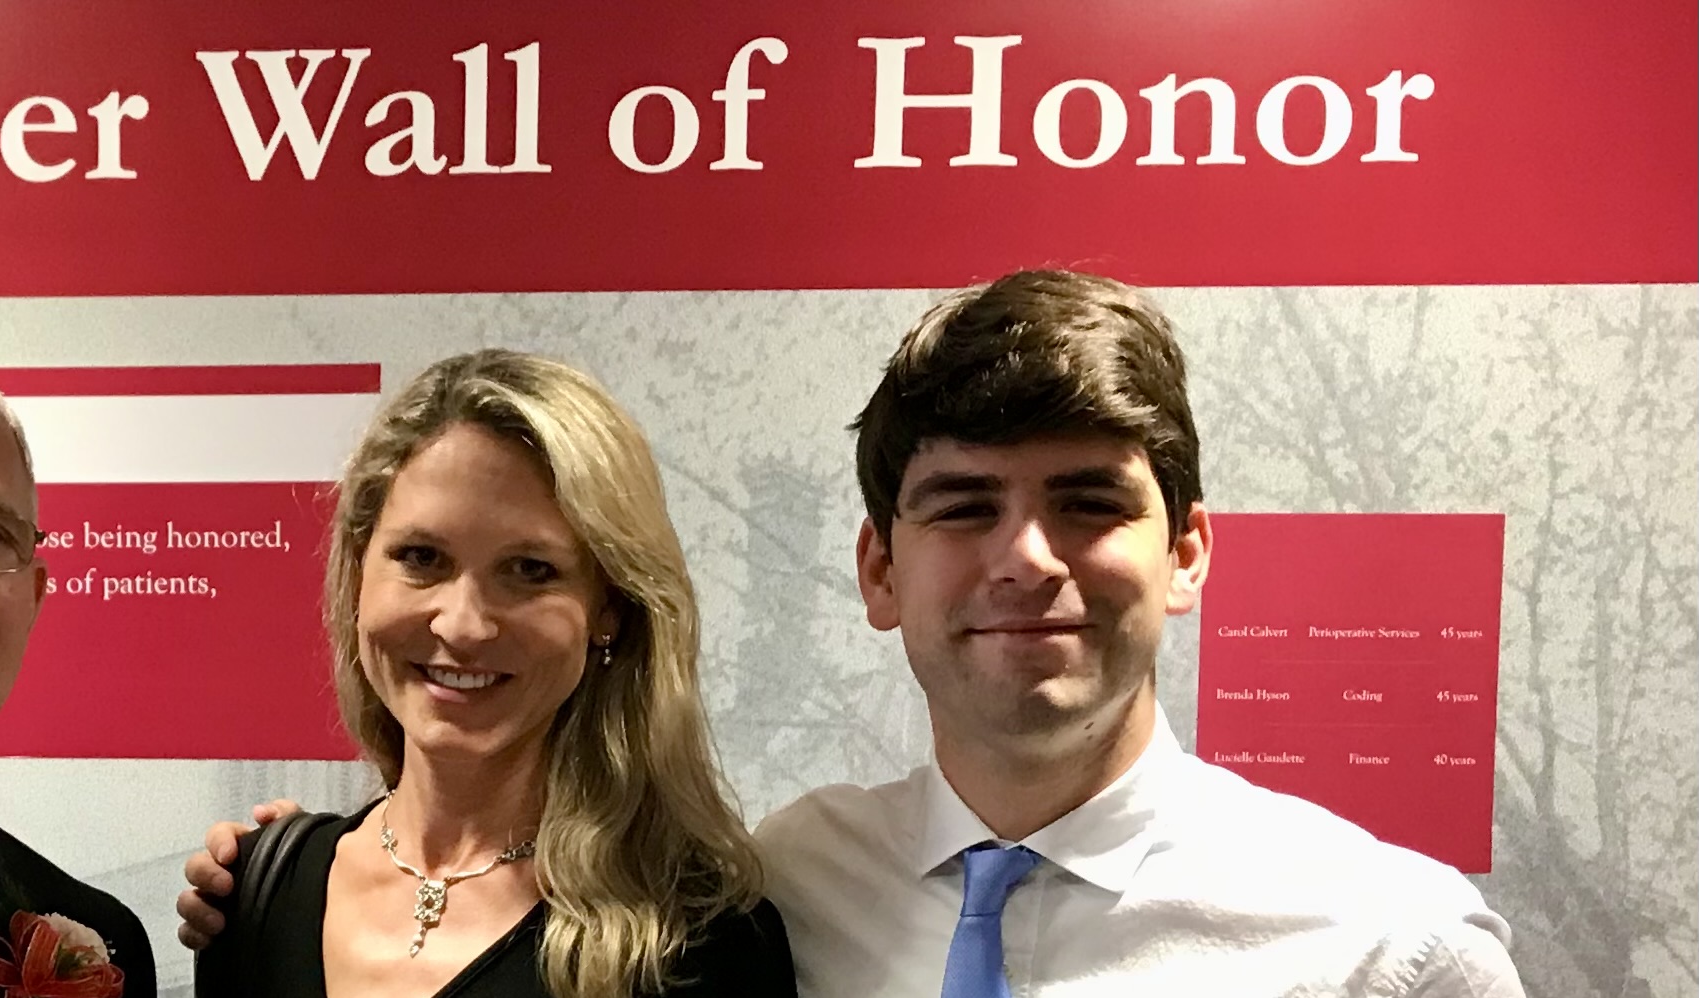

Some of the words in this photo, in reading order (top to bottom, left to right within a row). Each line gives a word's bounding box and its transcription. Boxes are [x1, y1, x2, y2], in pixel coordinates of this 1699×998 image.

[196, 43, 551, 181] Wall
[609, 38, 788, 173] of
[854, 35, 1435, 168] Honor
[83, 521, 157, 554] being
[167, 520, 290, 552] honored,
[66, 568, 96, 594] of
[103, 571, 216, 600] patients,
[1218, 626, 1248, 638] Carol
[1250, 626, 1288, 638] Calvert
[1308, 626, 1375, 640] Perioperative
[1378, 626, 1420, 639] Services
[1440, 627, 1454, 639] 45
[1456, 630, 1483, 640] years
[1216, 688, 1254, 701] Brenda
[1343, 690, 1382, 702] Coding
[1437, 691, 1450, 702] 45
[1452, 693, 1479, 703] years
[1257, 752, 1306, 764] Gaudette
[1349, 753, 1390, 765] Finance
[1434, 754, 1448, 765] 40
[1449, 756, 1476, 766] years
